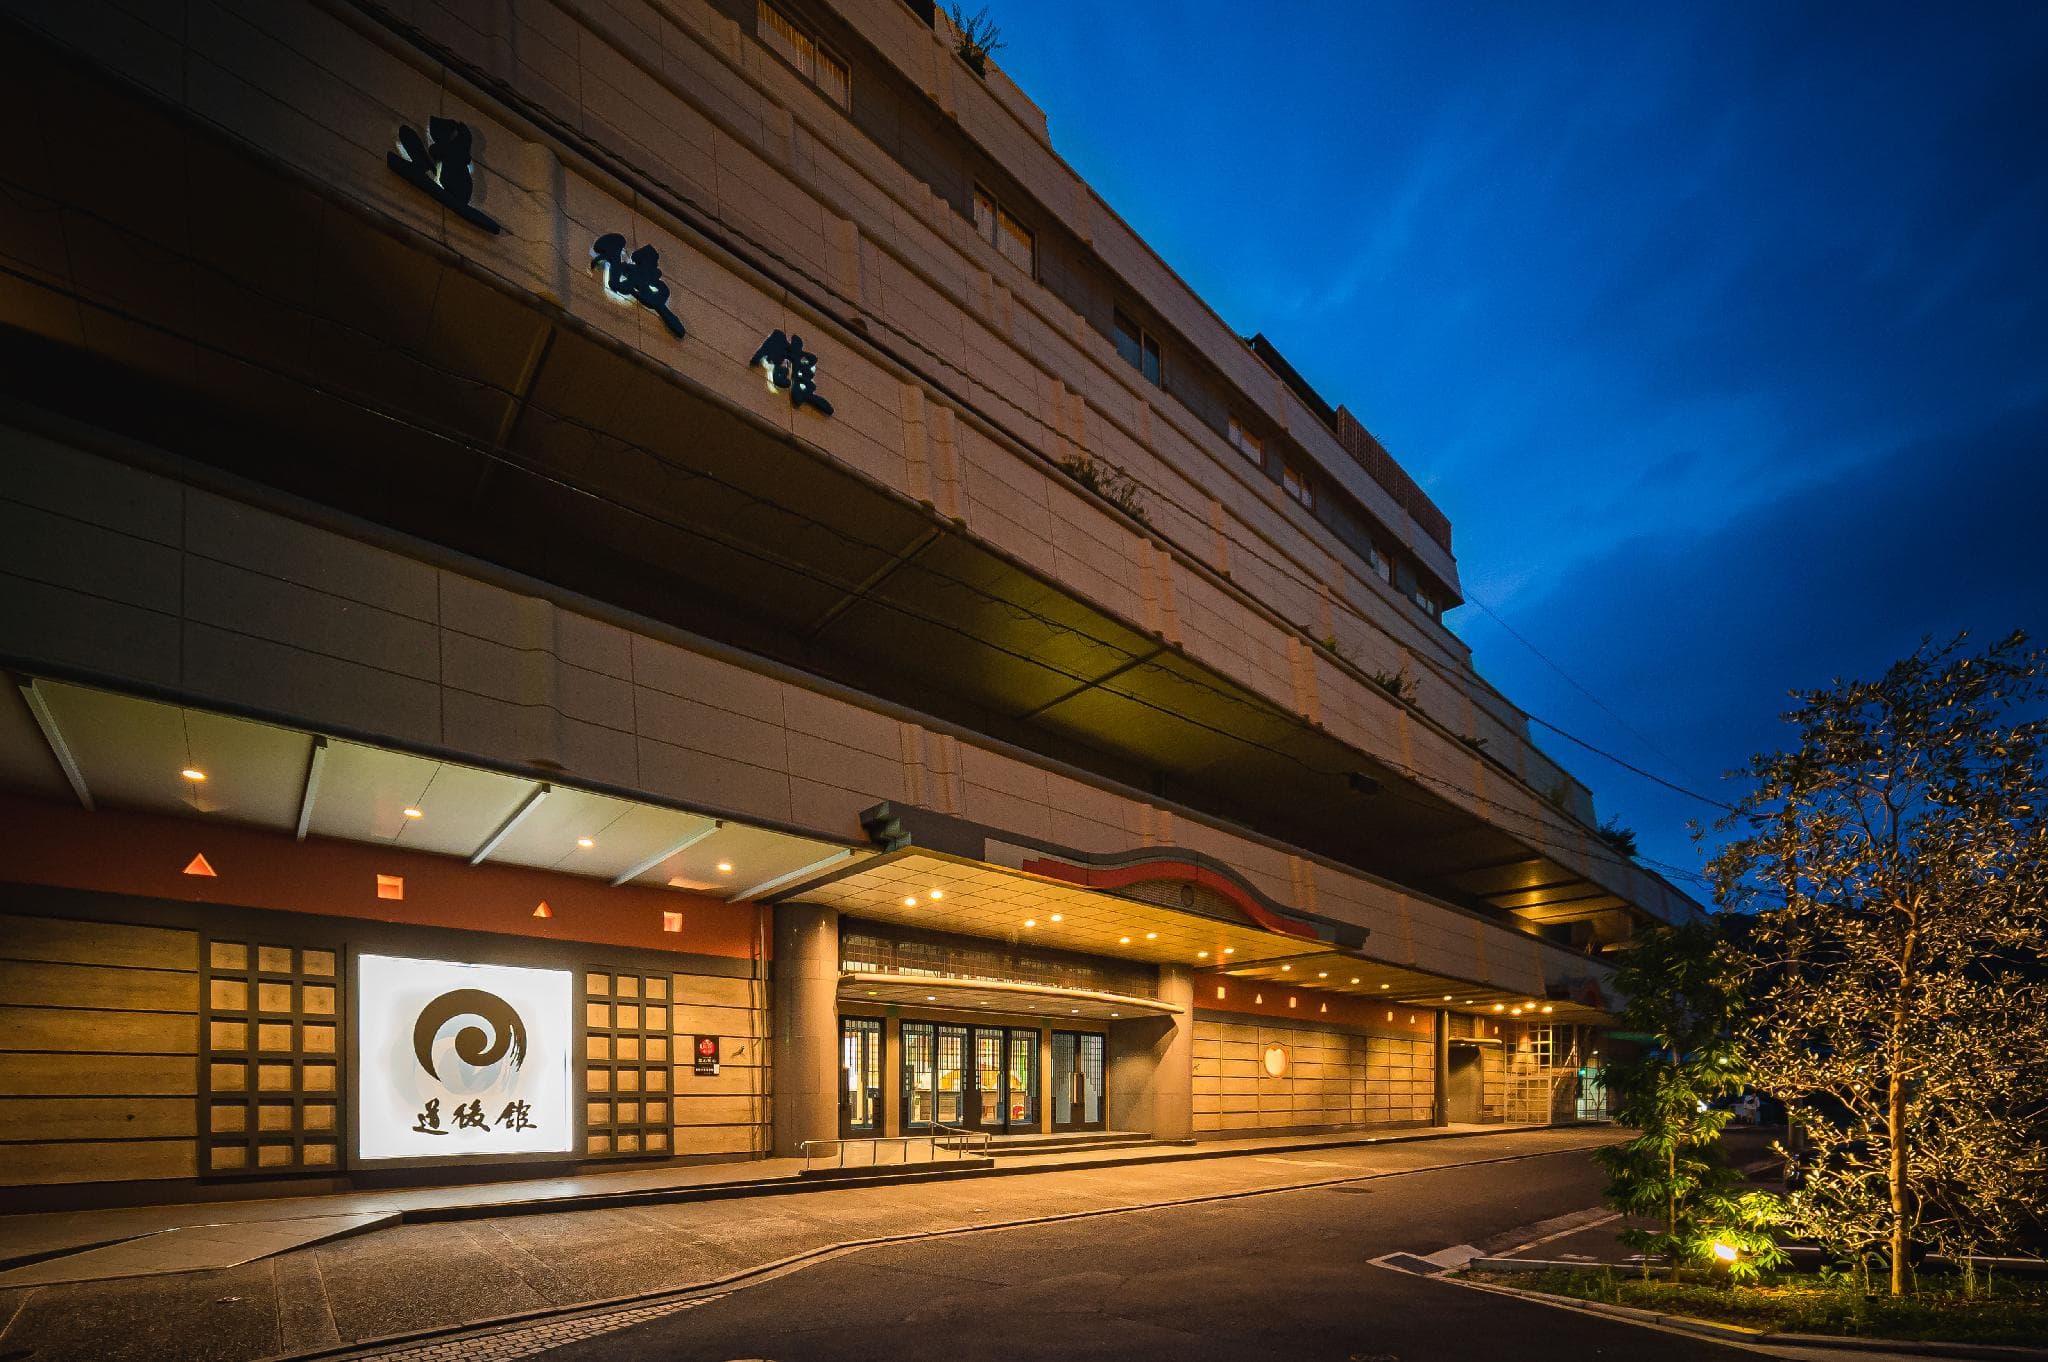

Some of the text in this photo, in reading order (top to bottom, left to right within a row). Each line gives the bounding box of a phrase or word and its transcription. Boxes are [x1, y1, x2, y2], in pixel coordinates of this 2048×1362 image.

[386, 115, 834, 415] 道後館
[412, 1098, 538, 1136] 道後館
